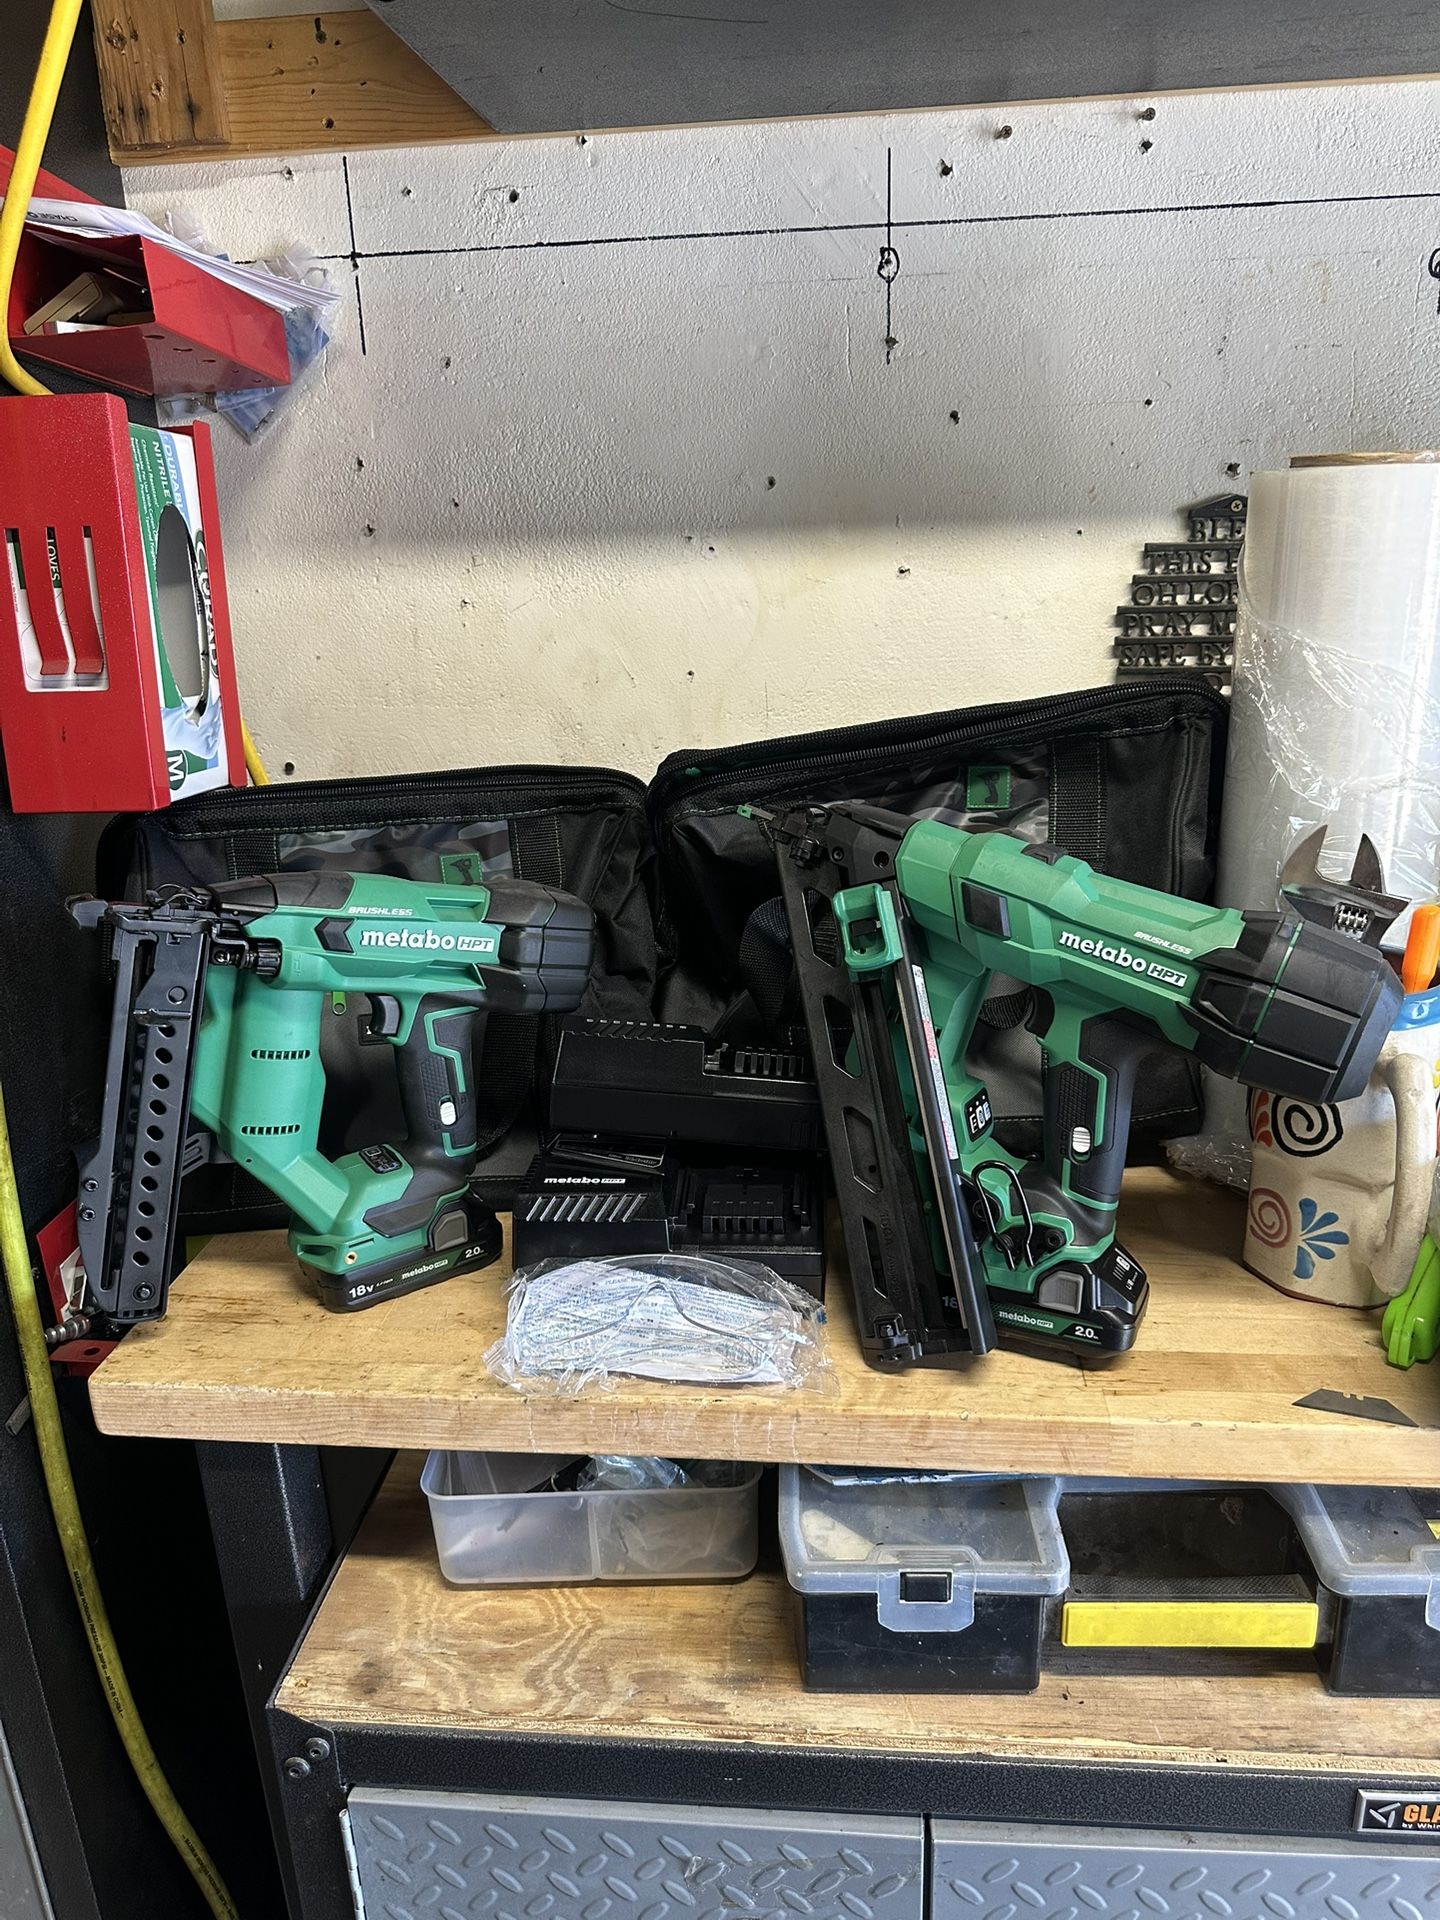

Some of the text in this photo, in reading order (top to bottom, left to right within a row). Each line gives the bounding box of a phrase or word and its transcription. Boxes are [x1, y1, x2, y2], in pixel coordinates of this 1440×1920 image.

[152, 441, 170, 498] NITRILE
[164, 444, 188, 515] DURABL
[1144, 550, 1212, 575] THIS
[1131, 582, 1178, 605] OH
[1121, 611, 1200, 637] PRAY
[1119, 642, 1233, 667] SAFE BY
[167, 754, 185, 781] M
[347, 906, 414, 916] BRUSHLESS
[360, 928, 494, 952] metabo HPT
[1134, 930, 1193, 955] BRUSHLESS
[1058, 930, 1186, 986] metabo HPT
[464, 1246, 480, 1258] 2.0
[401, 1263, 434, 1280] metabo
[348, 1283, 374, 1299] 18v
[999, 1310, 1036, 1325] metabo
[1074, 1326, 1094, 1339] 2.0
[1404, 1804, 1440, 1823] GLA
